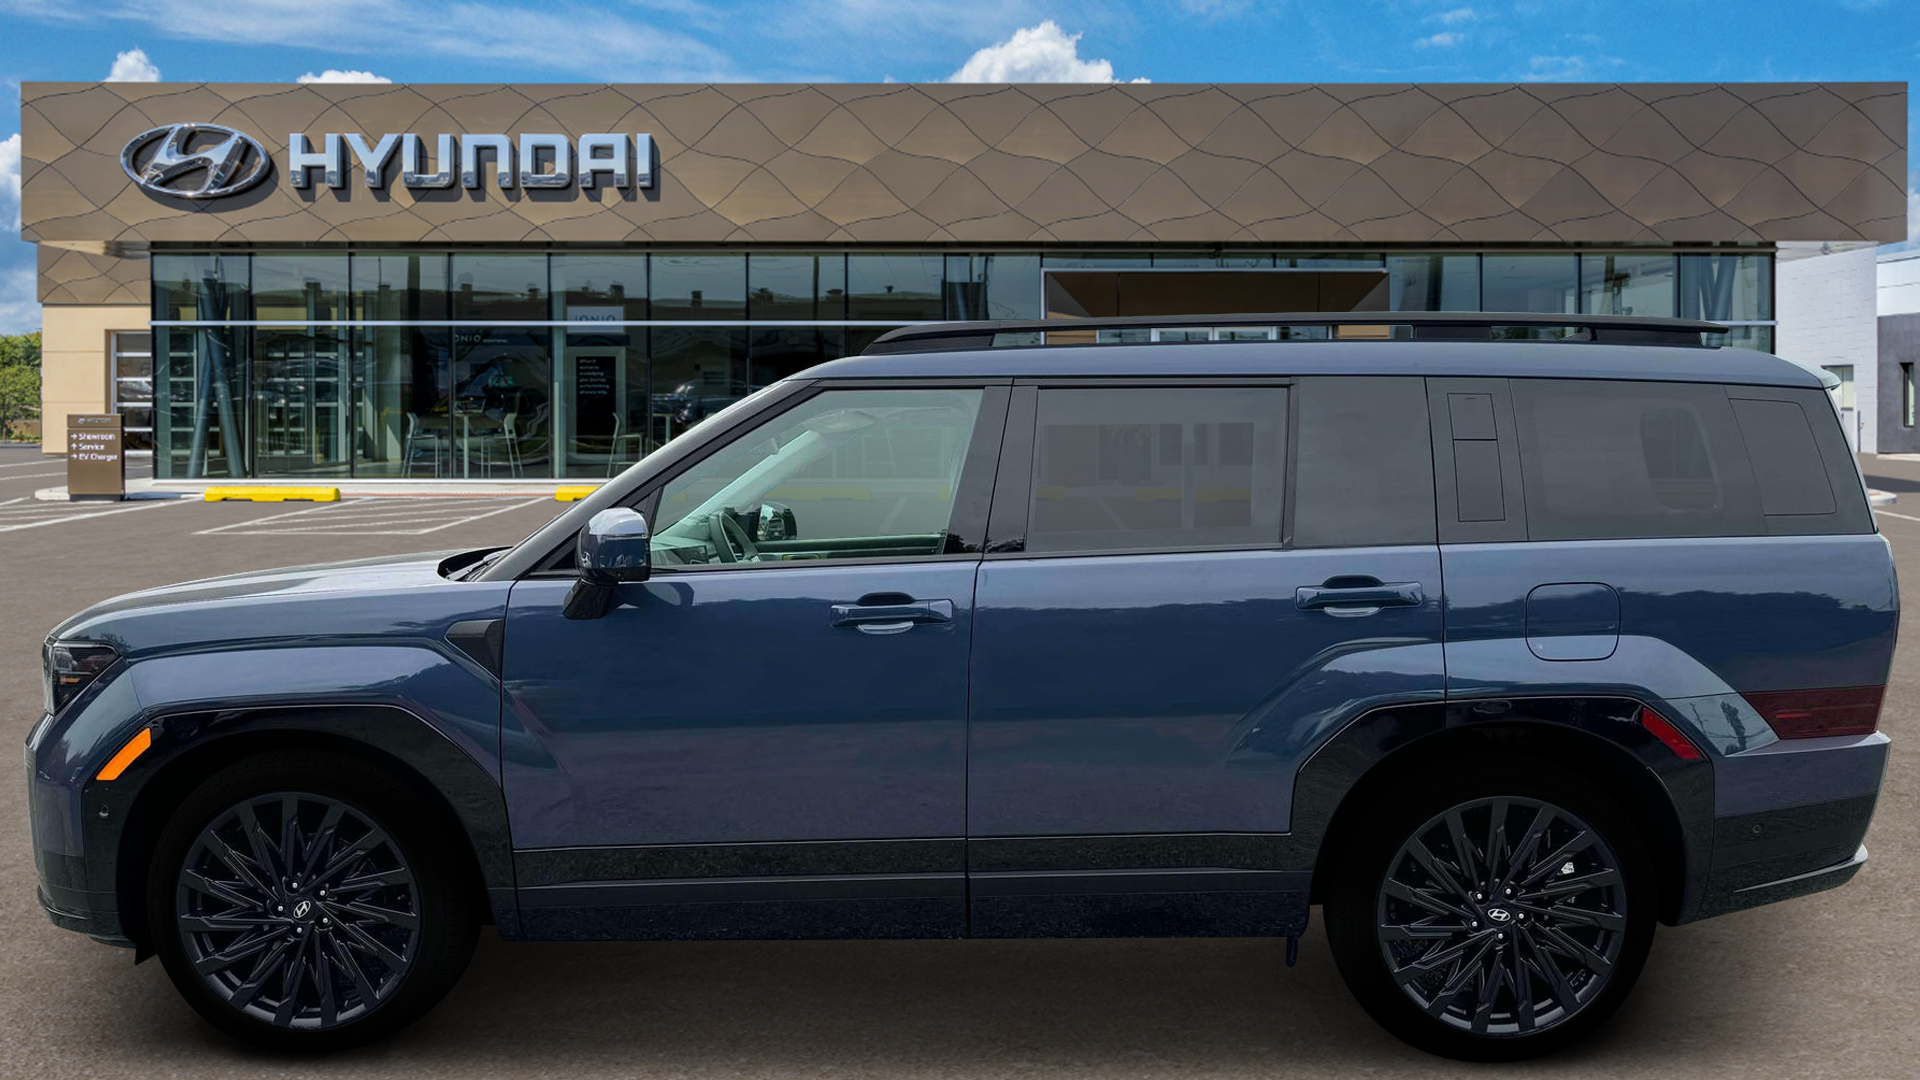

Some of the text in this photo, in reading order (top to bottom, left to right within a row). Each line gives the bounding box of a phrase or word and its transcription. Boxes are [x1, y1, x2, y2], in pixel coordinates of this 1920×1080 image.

[290, 133, 654, 189] HYUNDAI
[78, 442, 105, 450] Service
[90, 453, 118, 462] Charger
